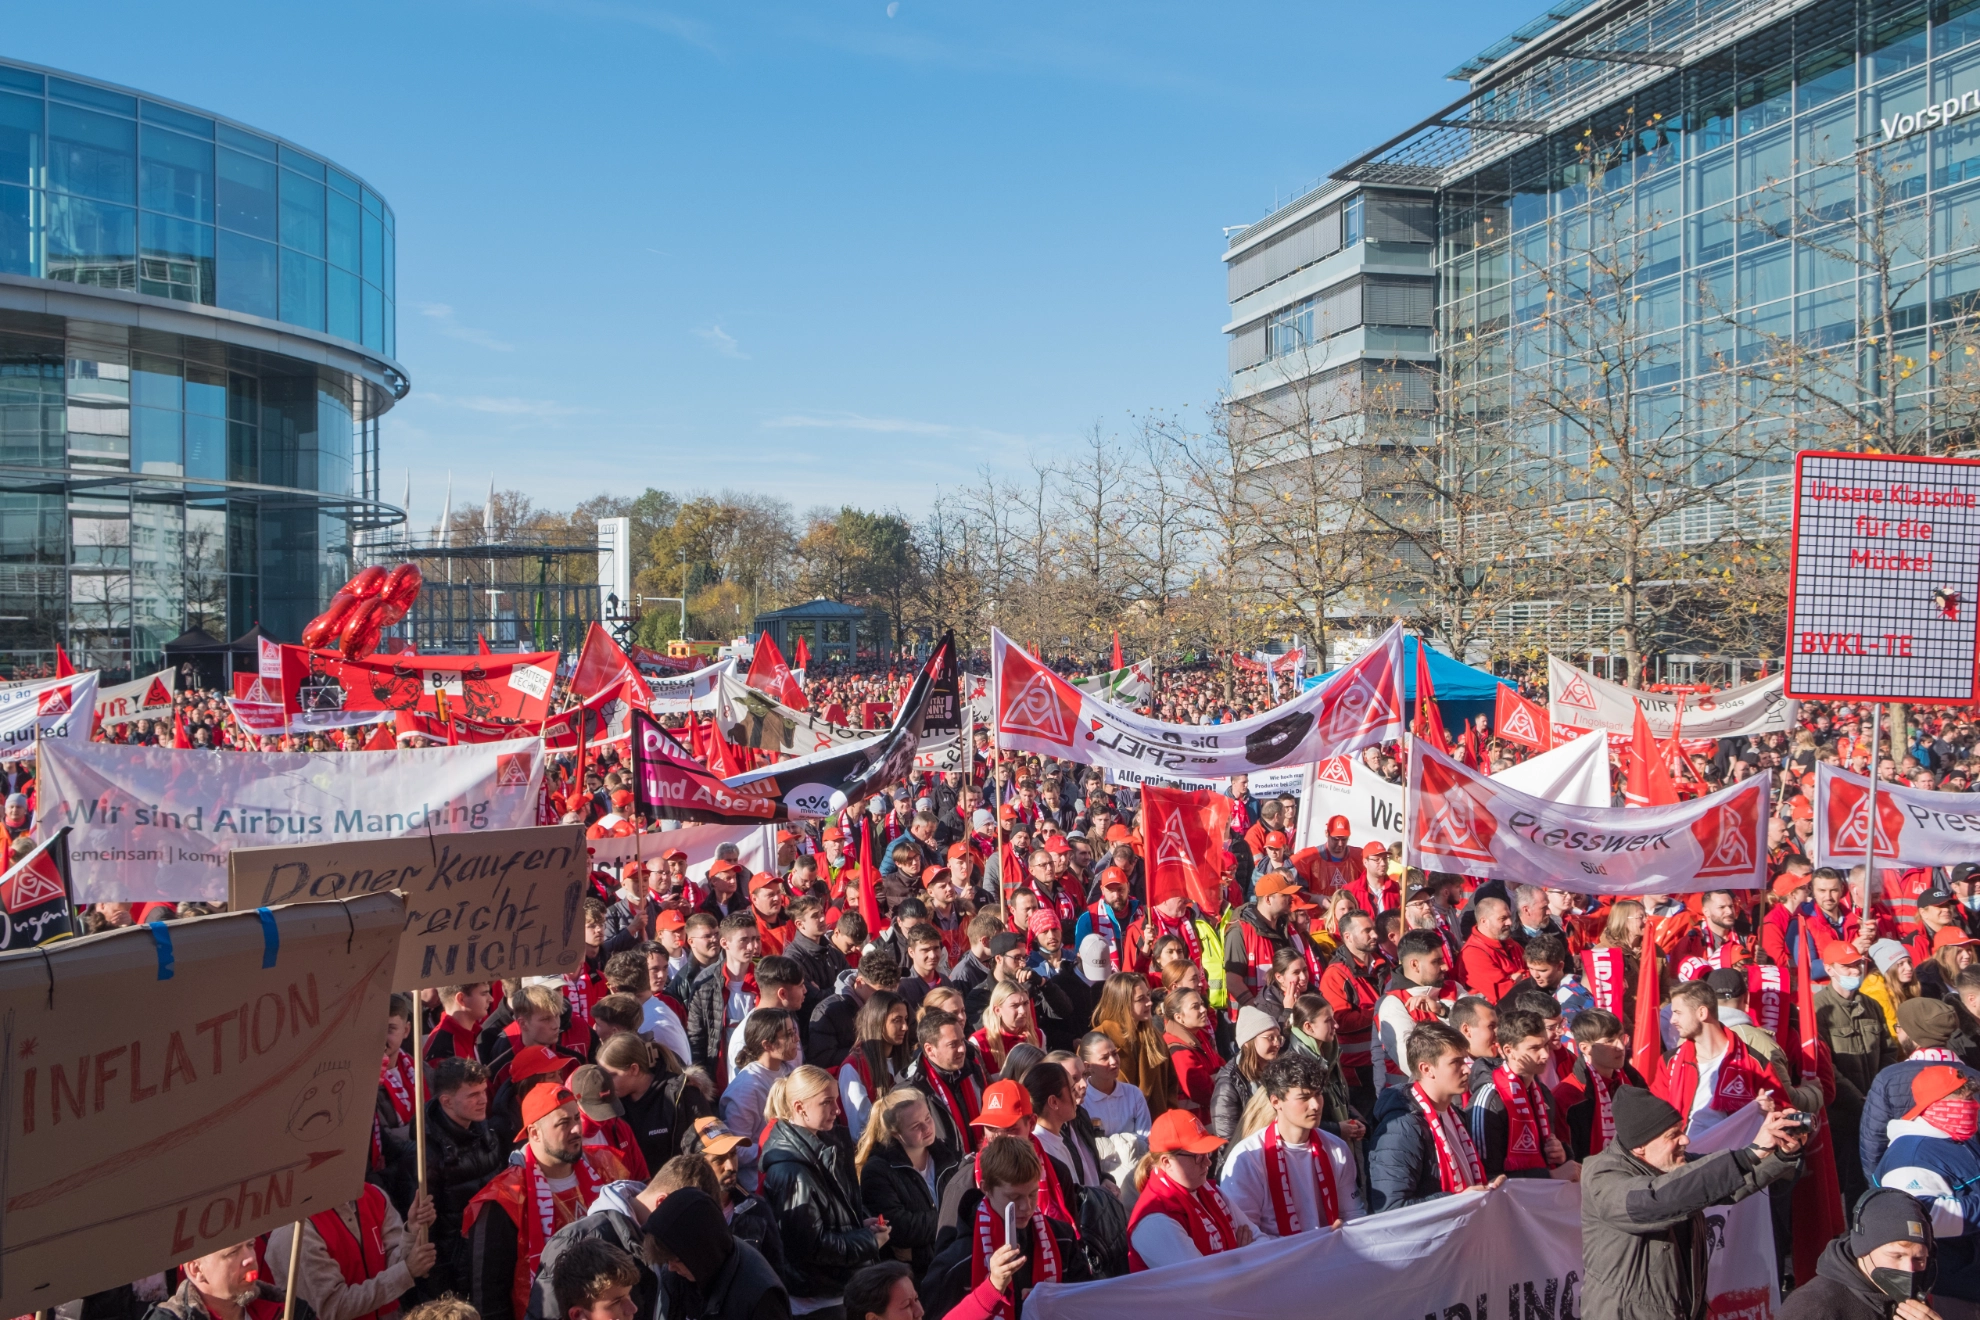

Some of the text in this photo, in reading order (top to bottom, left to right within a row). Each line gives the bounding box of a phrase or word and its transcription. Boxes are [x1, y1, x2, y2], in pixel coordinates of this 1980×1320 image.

[1811, 481, 1976, 509] Unsere Klatsche
[1856, 515, 1933, 539] für die
[1851, 549, 1933, 572] Mücke!
[519, 666, 549, 688] BATTERIE
[1719, 700, 1745, 711] 5049
[1579, 716, 1624, 731] Ingolstadt
[1118, 769, 1142, 784] Alle
[691, 785, 769, 813] Aber!
[64, 799, 489, 834] Wir sind Airbus Manching
[1508, 810, 1674, 853] Presswerk
[71, 846, 164, 862] emeinsam
[178, 847, 228, 867] komp
[1580, 861, 1608, 876] Süd
[402, 882, 541, 937] reicht
